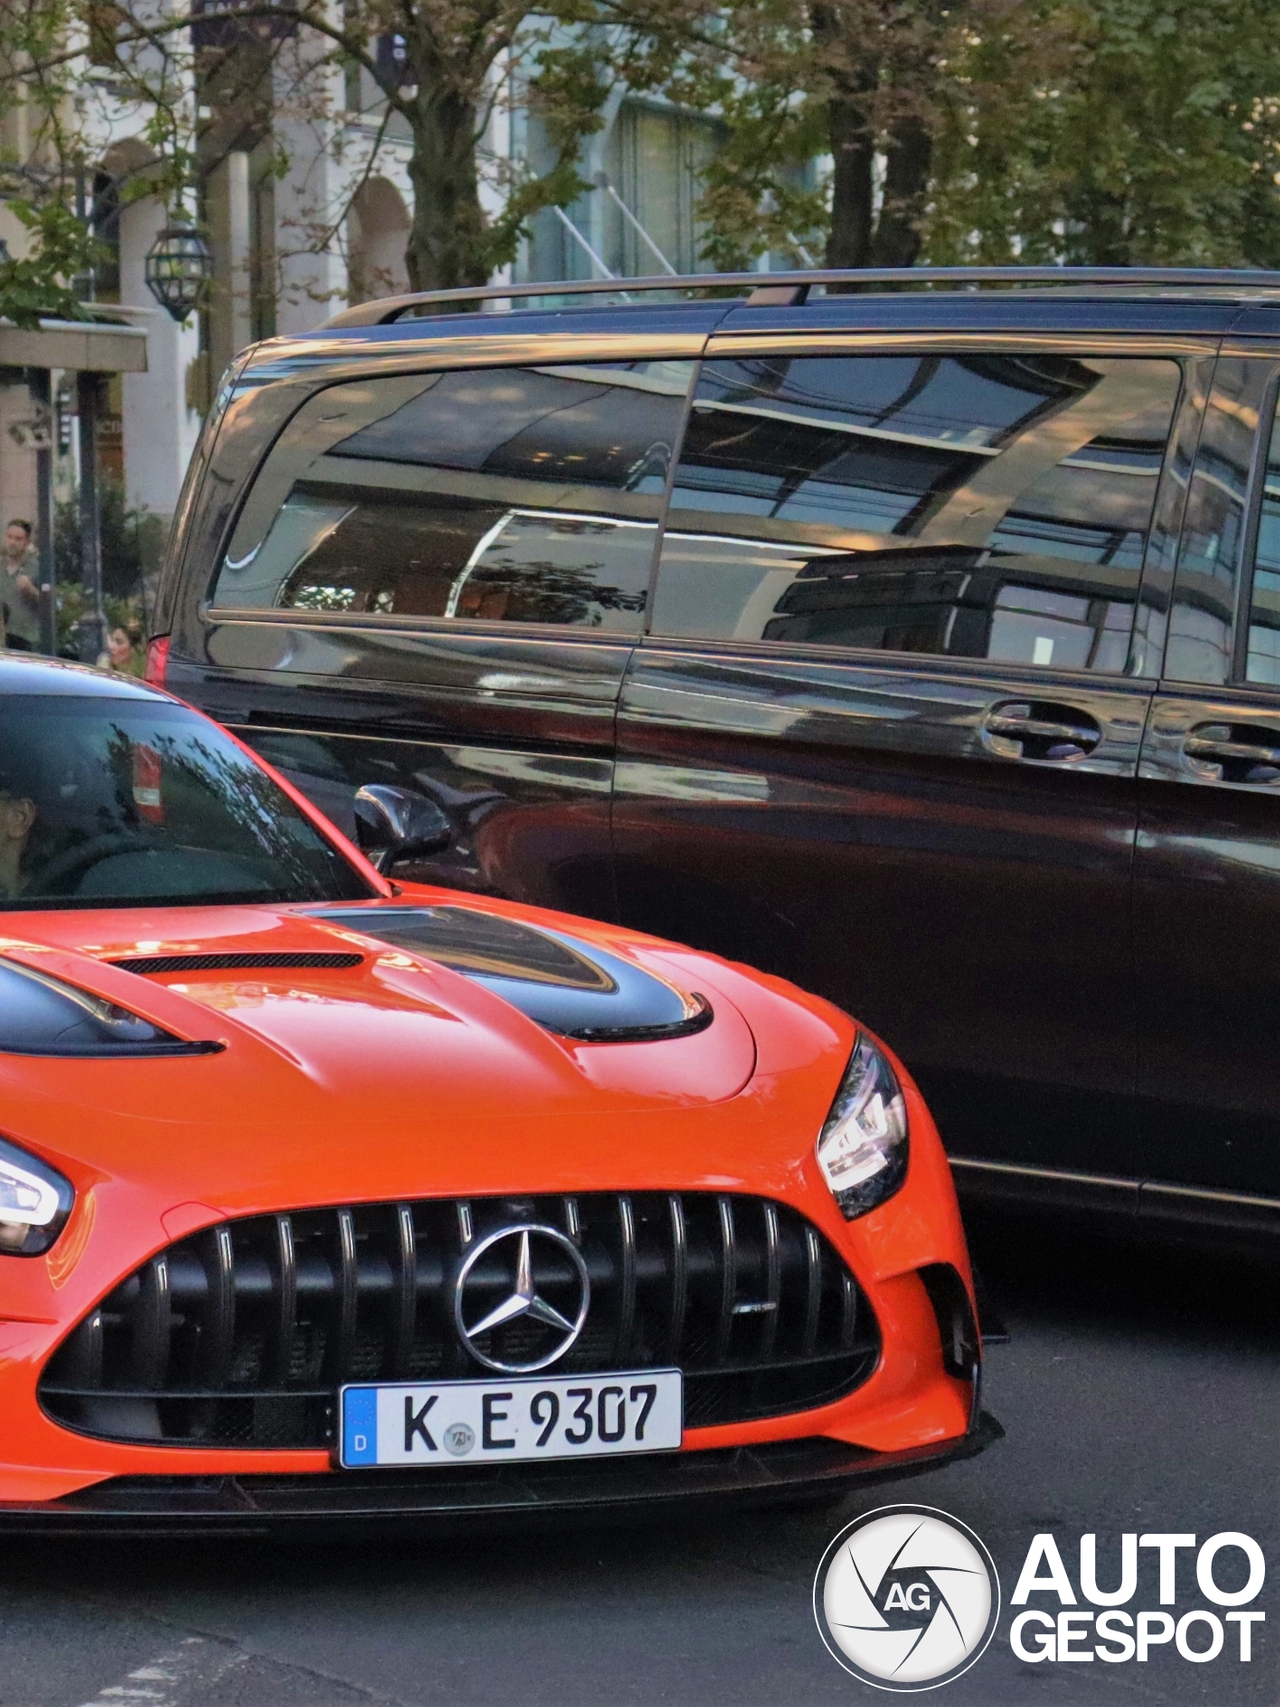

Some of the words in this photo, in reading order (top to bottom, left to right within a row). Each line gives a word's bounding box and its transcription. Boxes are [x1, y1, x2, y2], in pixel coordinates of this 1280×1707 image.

[404, 1396, 439, 1452] K
[482, 1392, 516, 1450] E
[530, 1384, 657, 1447] 9307
[354, 1435, 368, 1452] D
